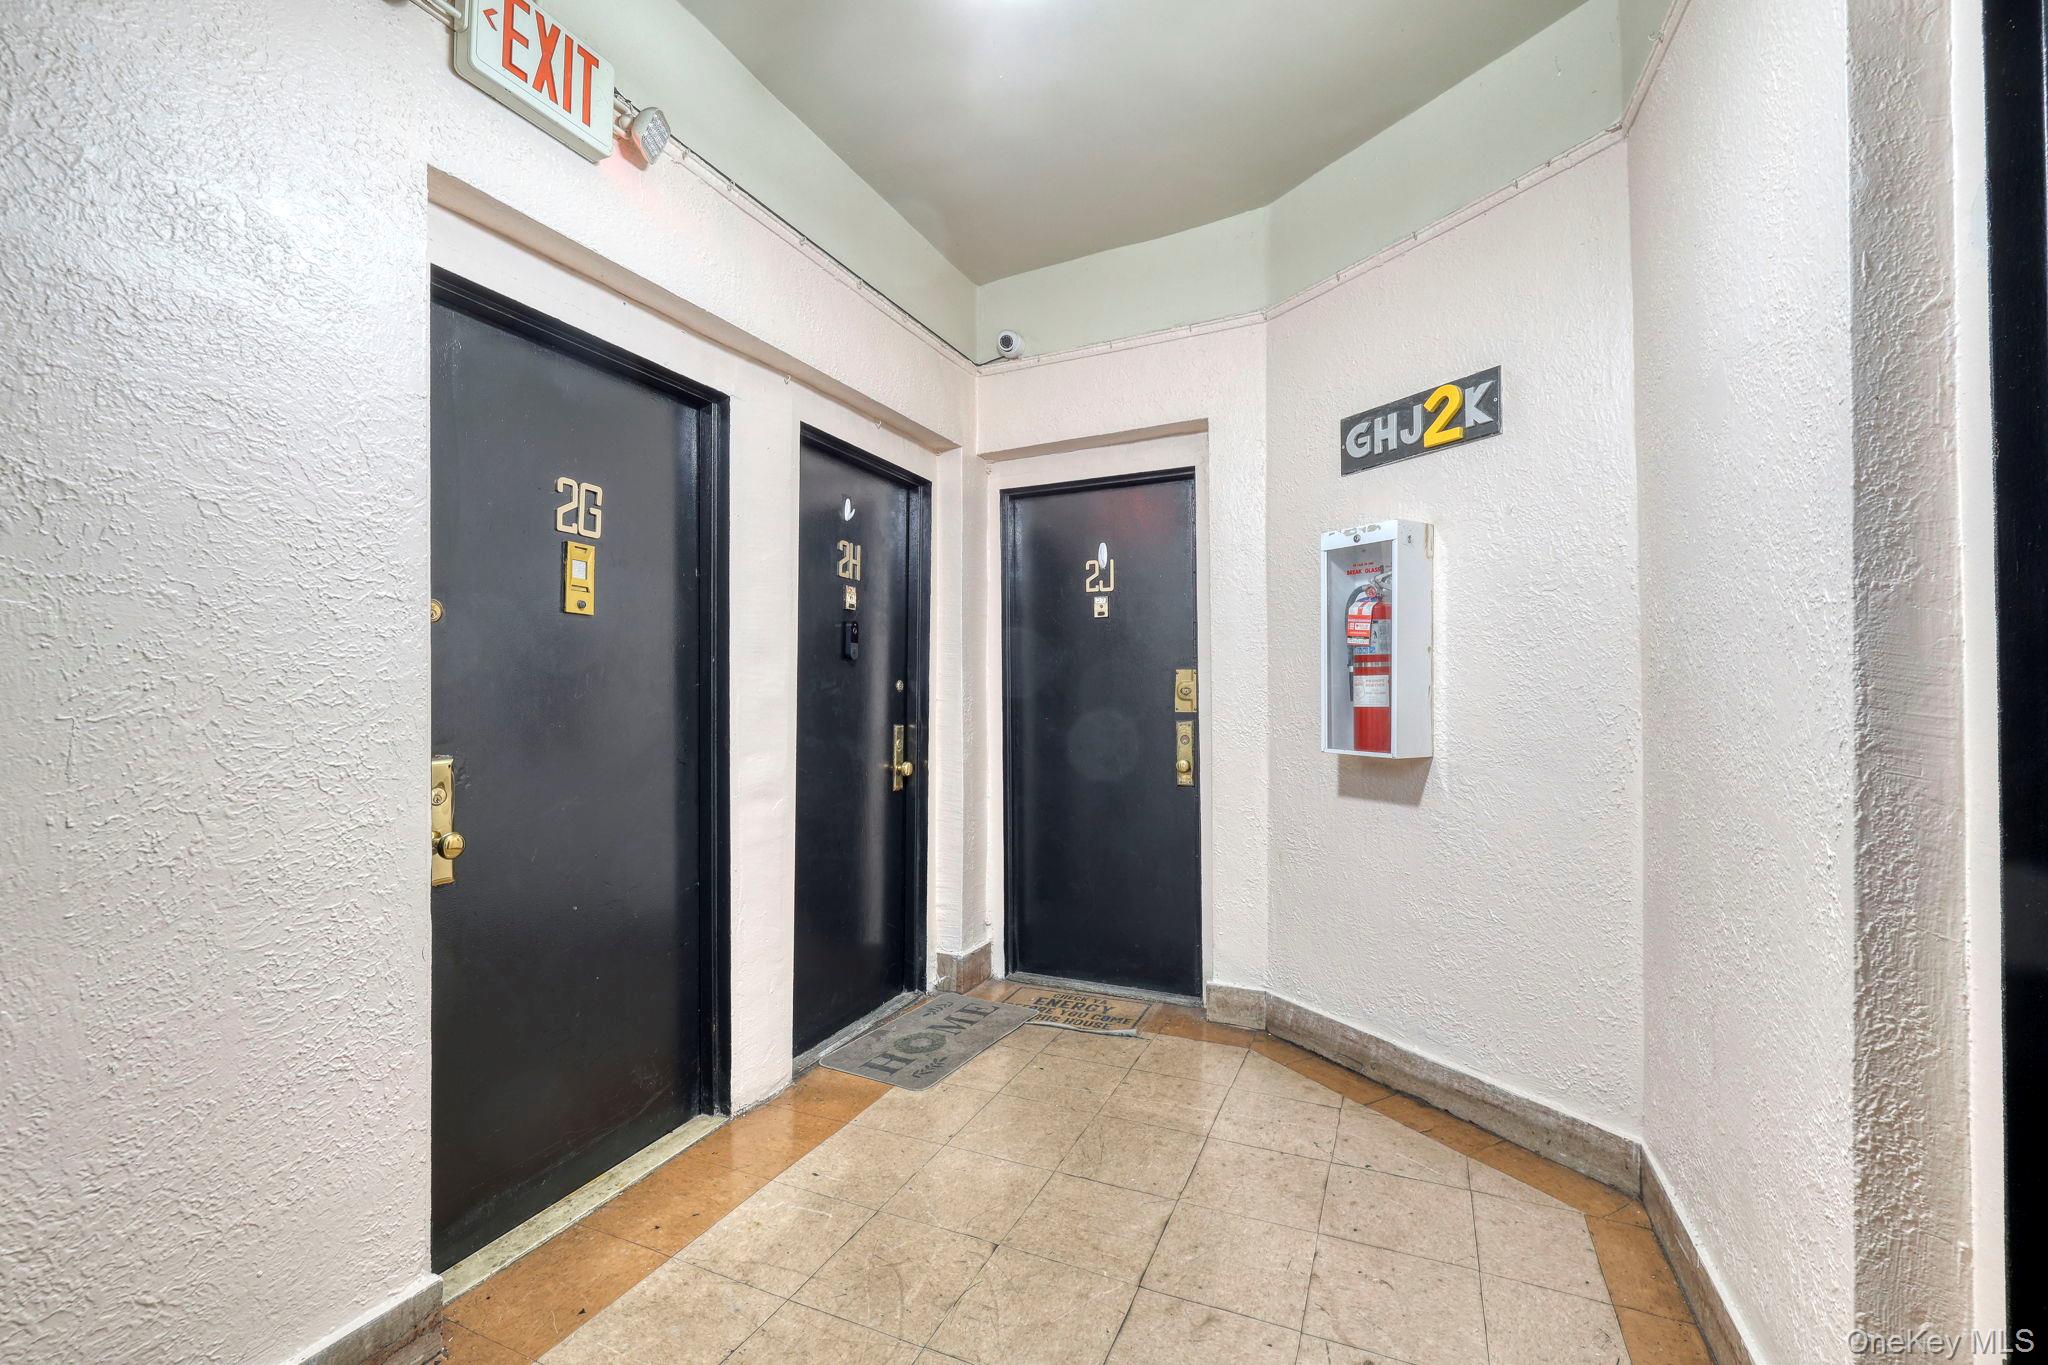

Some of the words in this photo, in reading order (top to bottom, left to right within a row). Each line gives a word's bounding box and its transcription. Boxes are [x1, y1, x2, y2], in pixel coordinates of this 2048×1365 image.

[502, 0, 600, 128] EXIT
[1345, 380, 1496, 459] GHJ2K
[556, 476, 603, 539] 2G
[837, 539, 862, 582] 2H
[1085, 558, 1115, 593] 2J
[1033, 996, 1116, 1014] ENERGY
[1053, 993, 1088, 1002] CHECK
[1060, 1008, 1089, 1019] YOU
[1090, 1013, 1134, 1025] COME
[858, 1002, 1000, 1077] HOME
[1062, 1018, 1113, 1030] HOUSE
